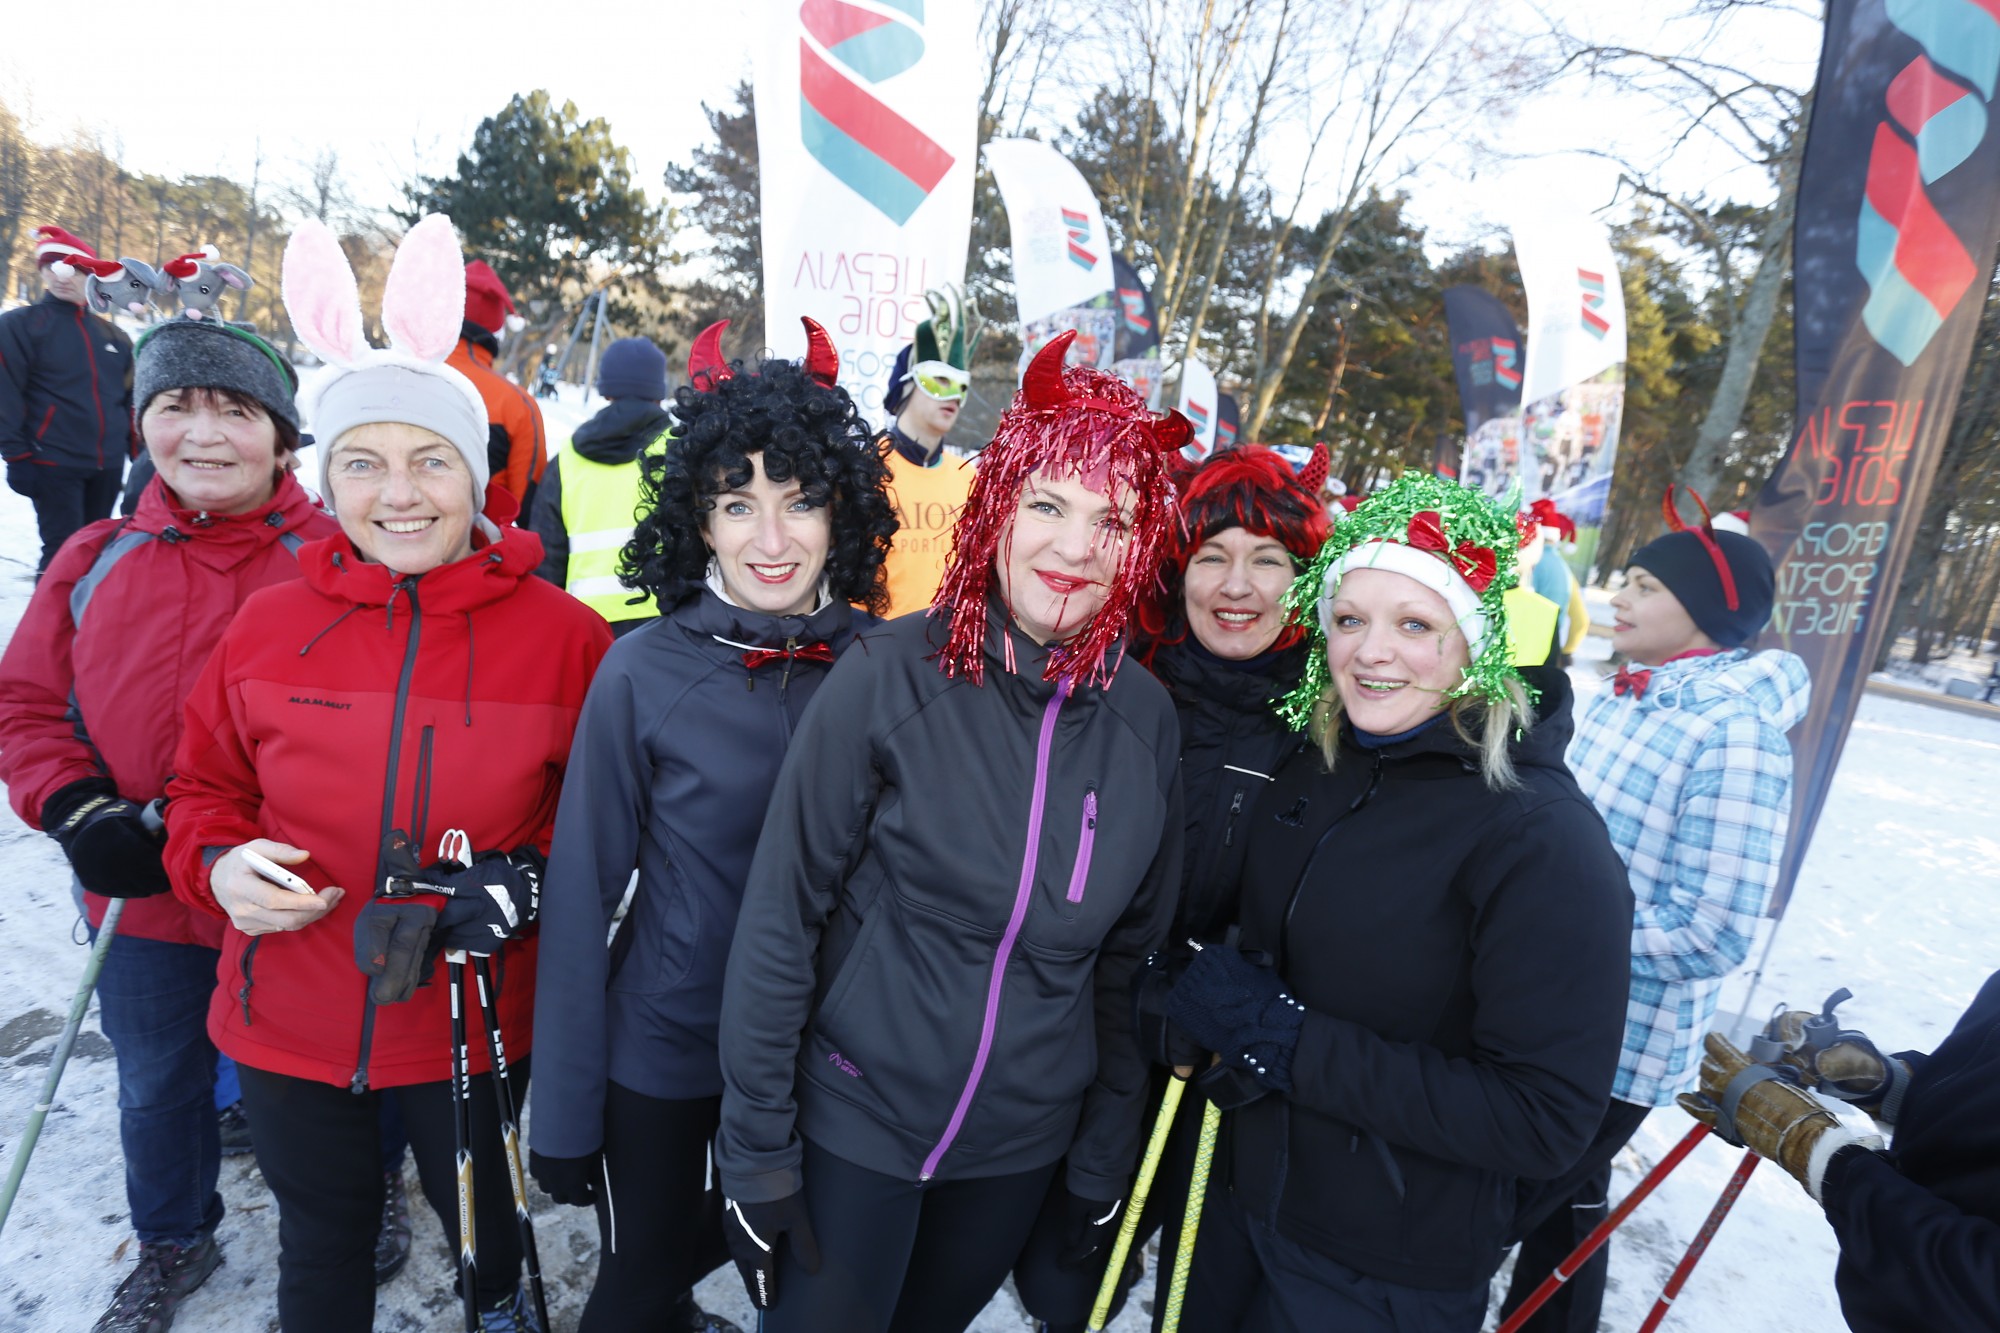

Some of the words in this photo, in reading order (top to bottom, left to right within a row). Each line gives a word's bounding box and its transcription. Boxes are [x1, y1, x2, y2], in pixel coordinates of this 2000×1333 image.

[288, 697, 352, 710] MAMMUT
[527, 871, 540, 921] LEKI
[460, 1044, 470, 1100] LEKI
[492, 1029, 509, 1079] LEKI
